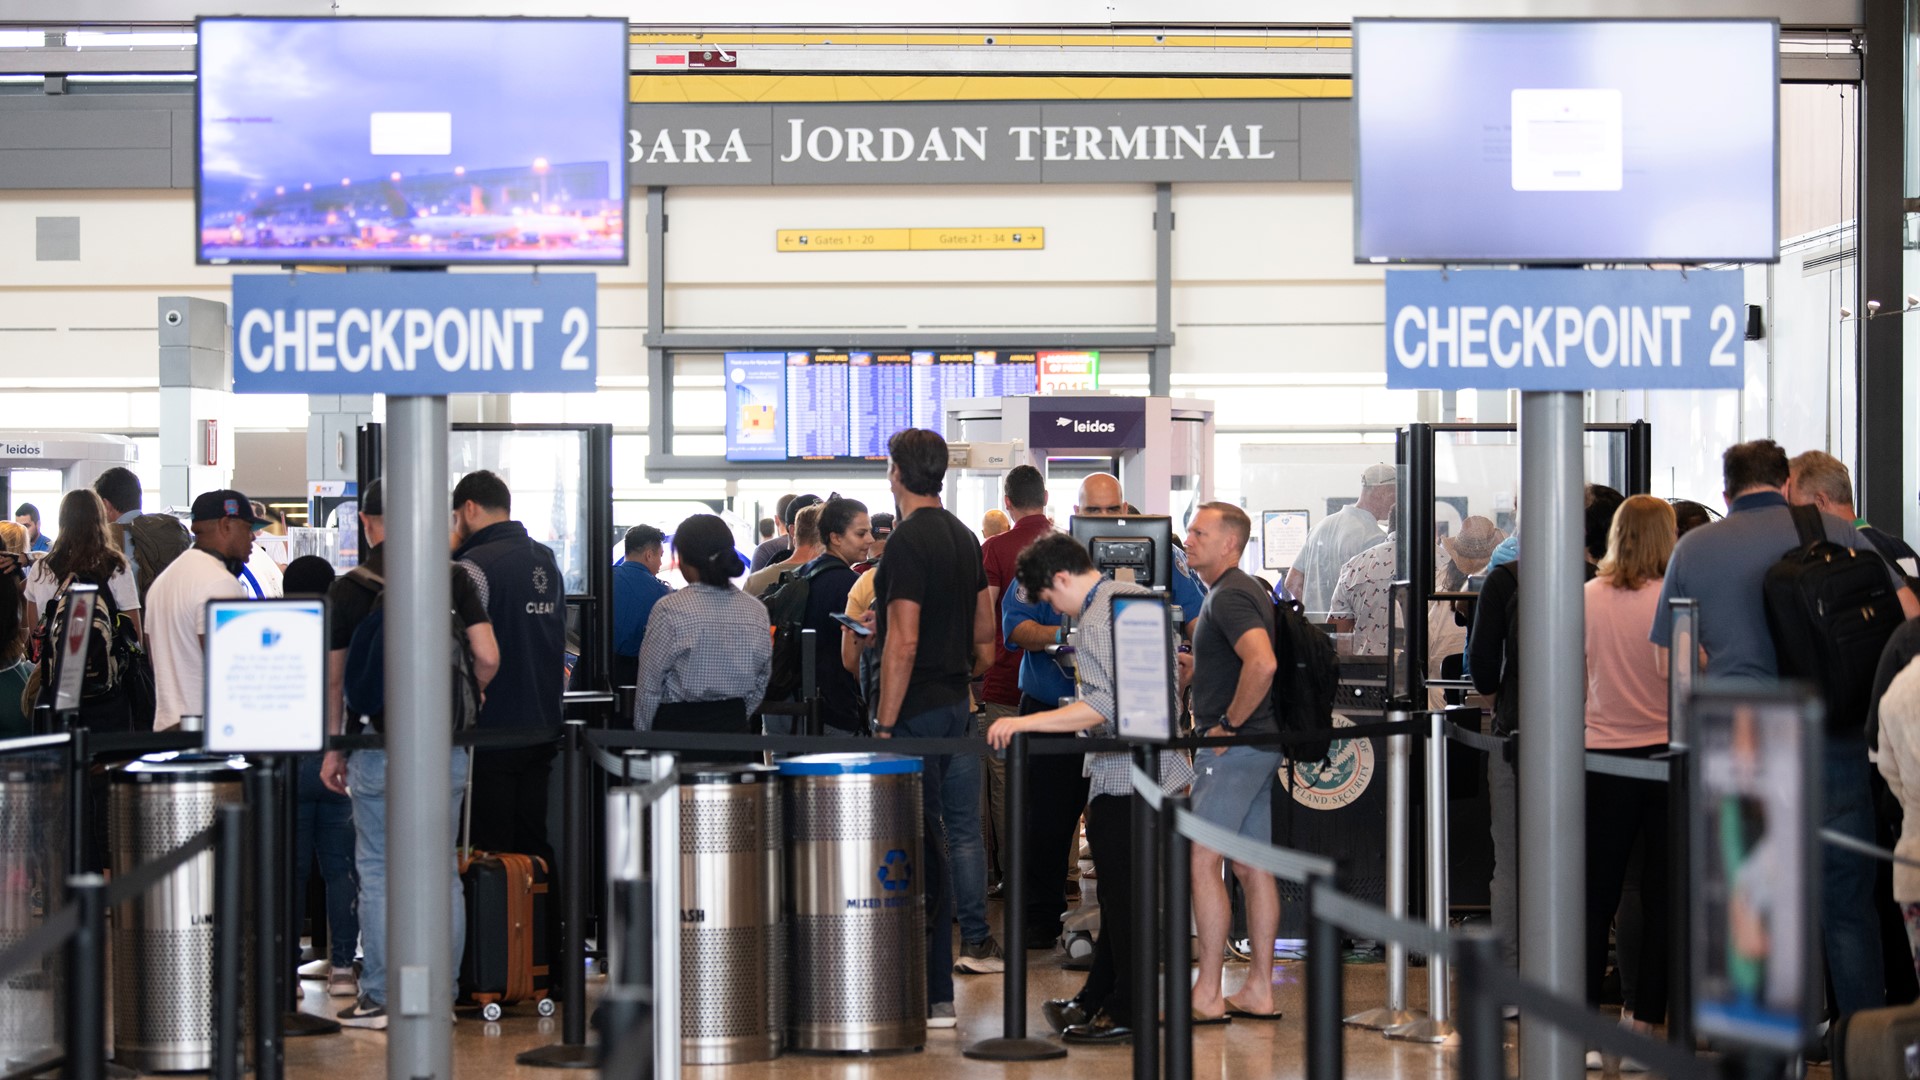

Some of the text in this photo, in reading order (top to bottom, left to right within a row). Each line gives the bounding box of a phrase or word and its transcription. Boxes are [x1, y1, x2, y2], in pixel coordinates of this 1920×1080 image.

[780, 118, 989, 163] JORDAN
[1008, 124, 1276, 161] TERMINAL
[814, 235, 843, 246] Gates
[847, 235, 852, 245] 1
[862, 235, 875, 245] 20
[938, 233, 968, 244] Gates
[970, 233, 983, 244] 21
[993, 233, 1006, 243] 34
[238, 306, 590, 373] CHECKPOINT 2
[1393, 303, 1737, 370] CHECKPOINT 2
[814, 354, 849, 362] DEPARTURES
[877, 354, 911, 362] DEPARTURES
[939, 354, 974, 362] DEPARTURES
[1009, 354, 1036, 362] ARRIVALS
[1074, 418, 1116, 434] leidos
[6, 443, 41, 456] leidos
[1359, 740, 1370, 753] OF
[1331, 764, 1370, 805] SECURITY
[846, 898, 882, 909] MIXED
